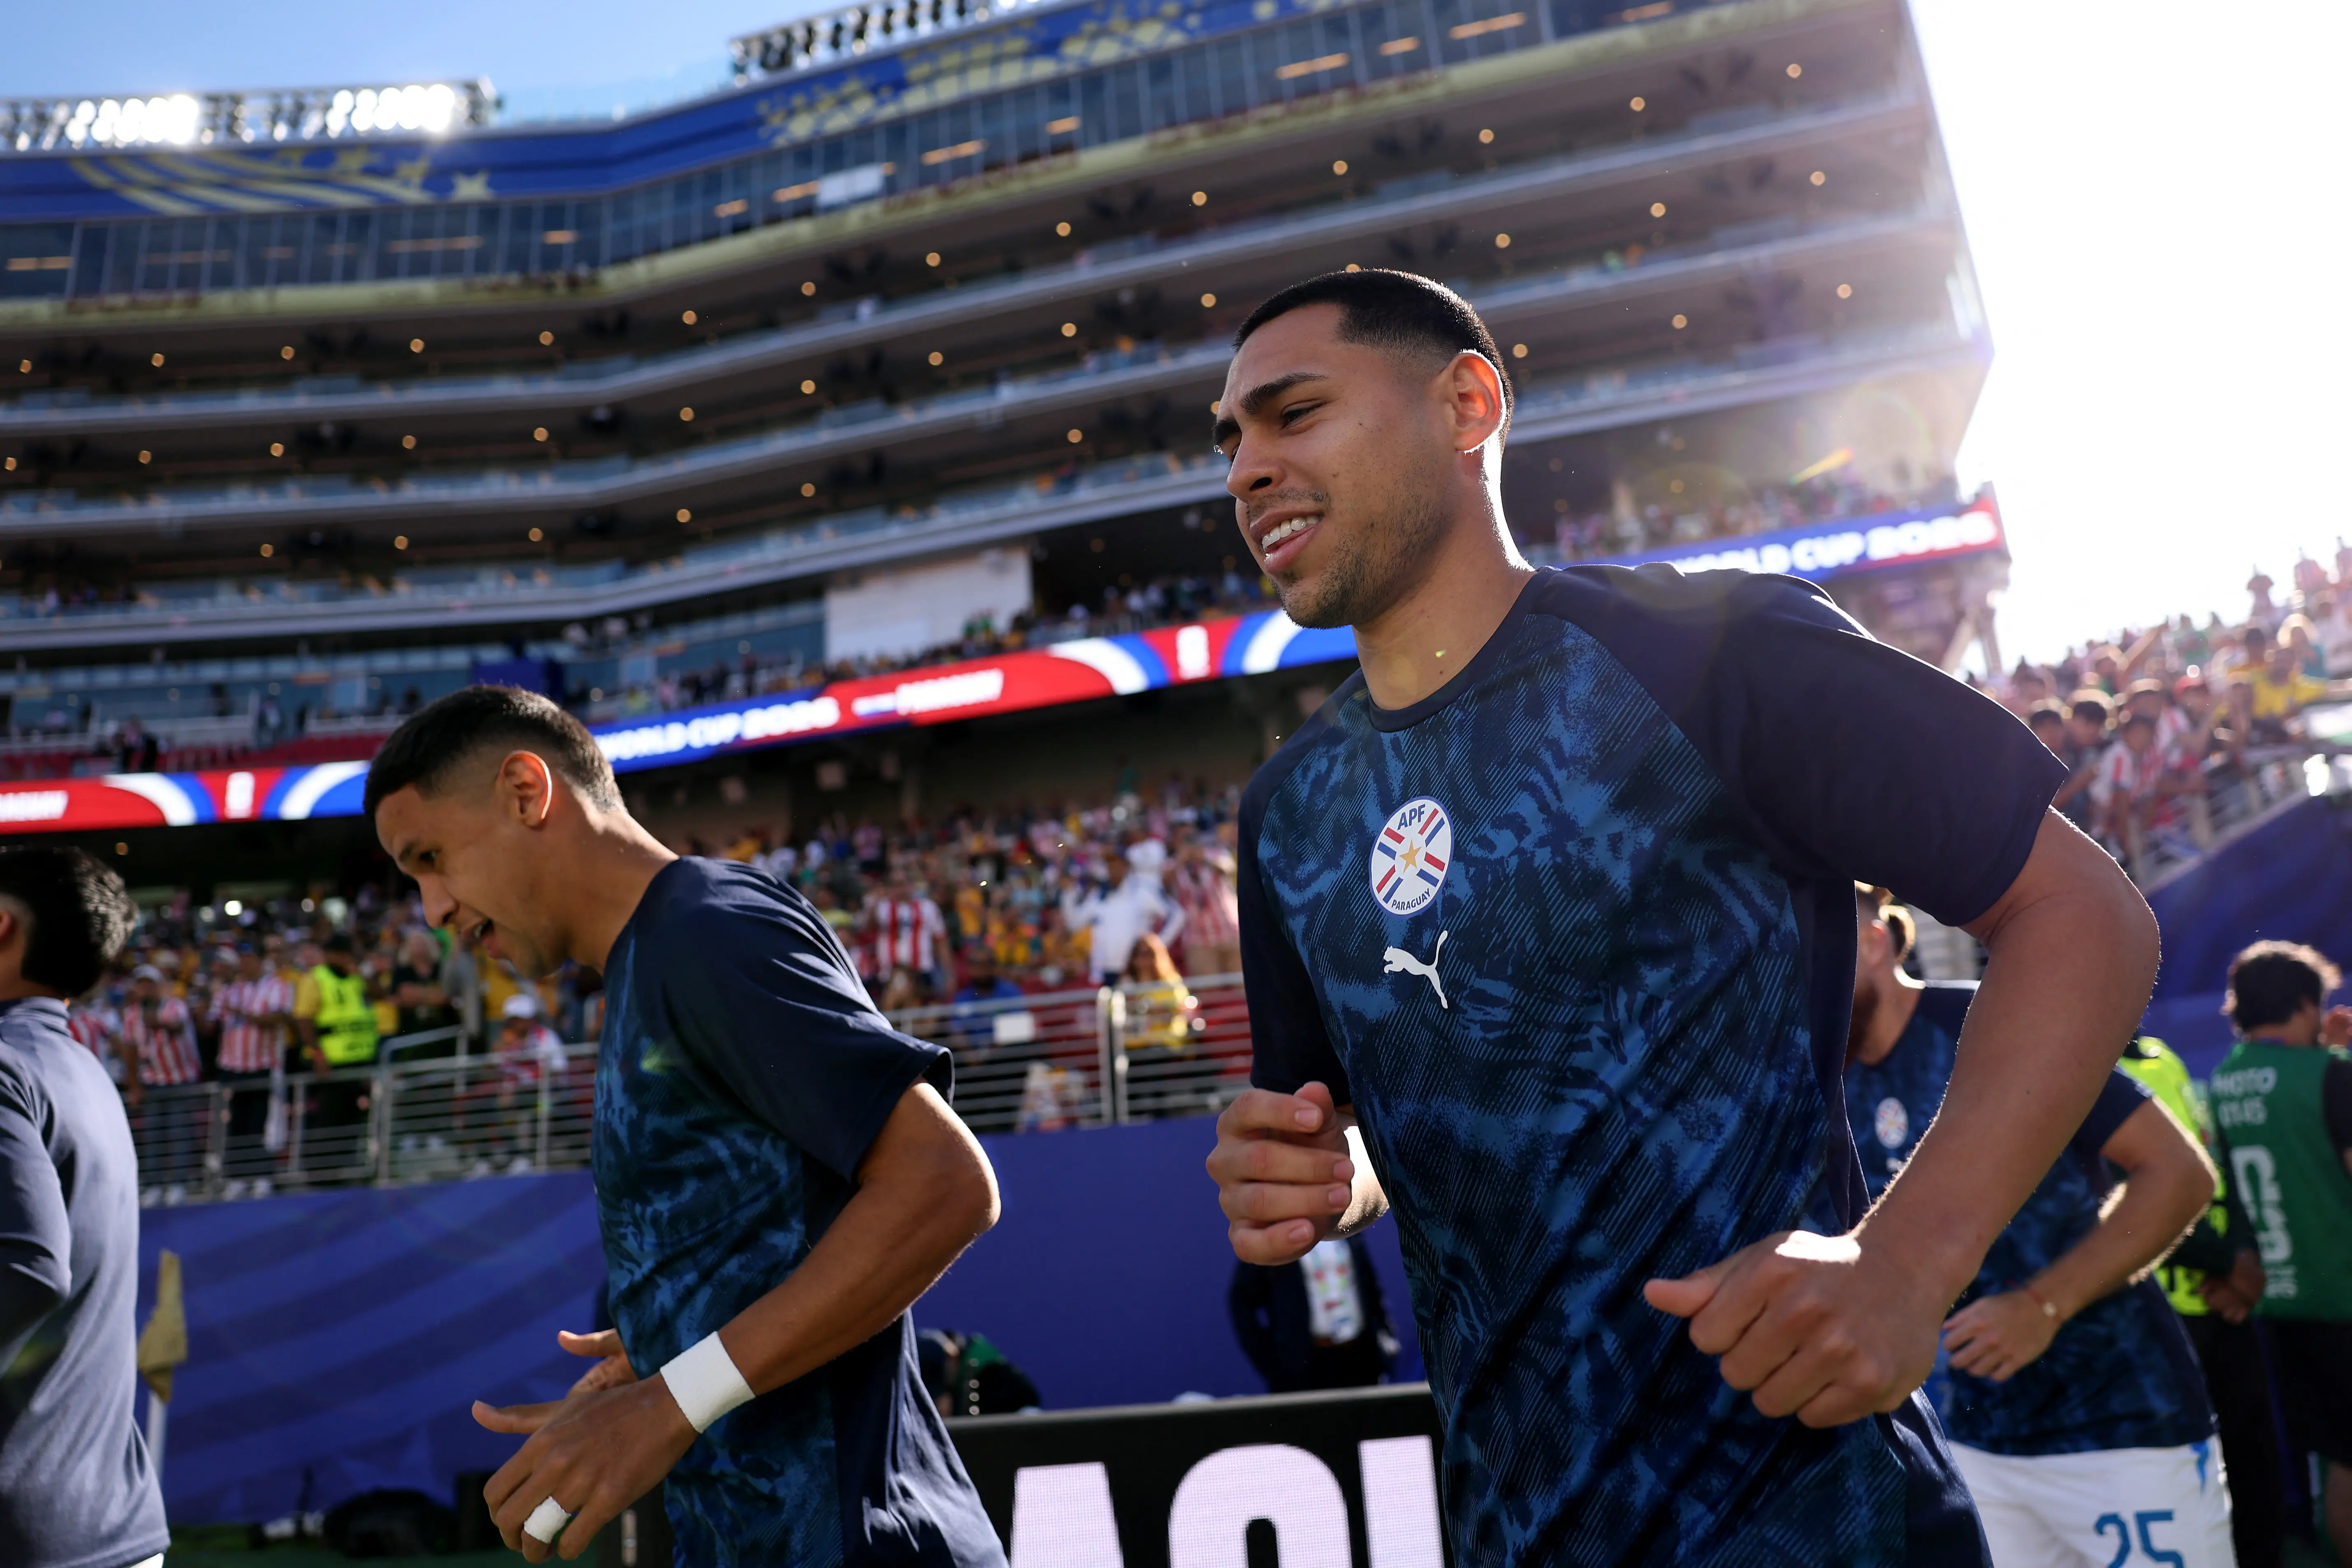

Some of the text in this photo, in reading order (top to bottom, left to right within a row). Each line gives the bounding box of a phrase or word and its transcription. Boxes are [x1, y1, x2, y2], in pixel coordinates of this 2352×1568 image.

[688, 712, 741, 748] CUP
[1397, 804, 1426, 830] APF
[1391, 888, 1431, 911] PARAGUAY
[2093, 1509, 2186, 1568] 25
